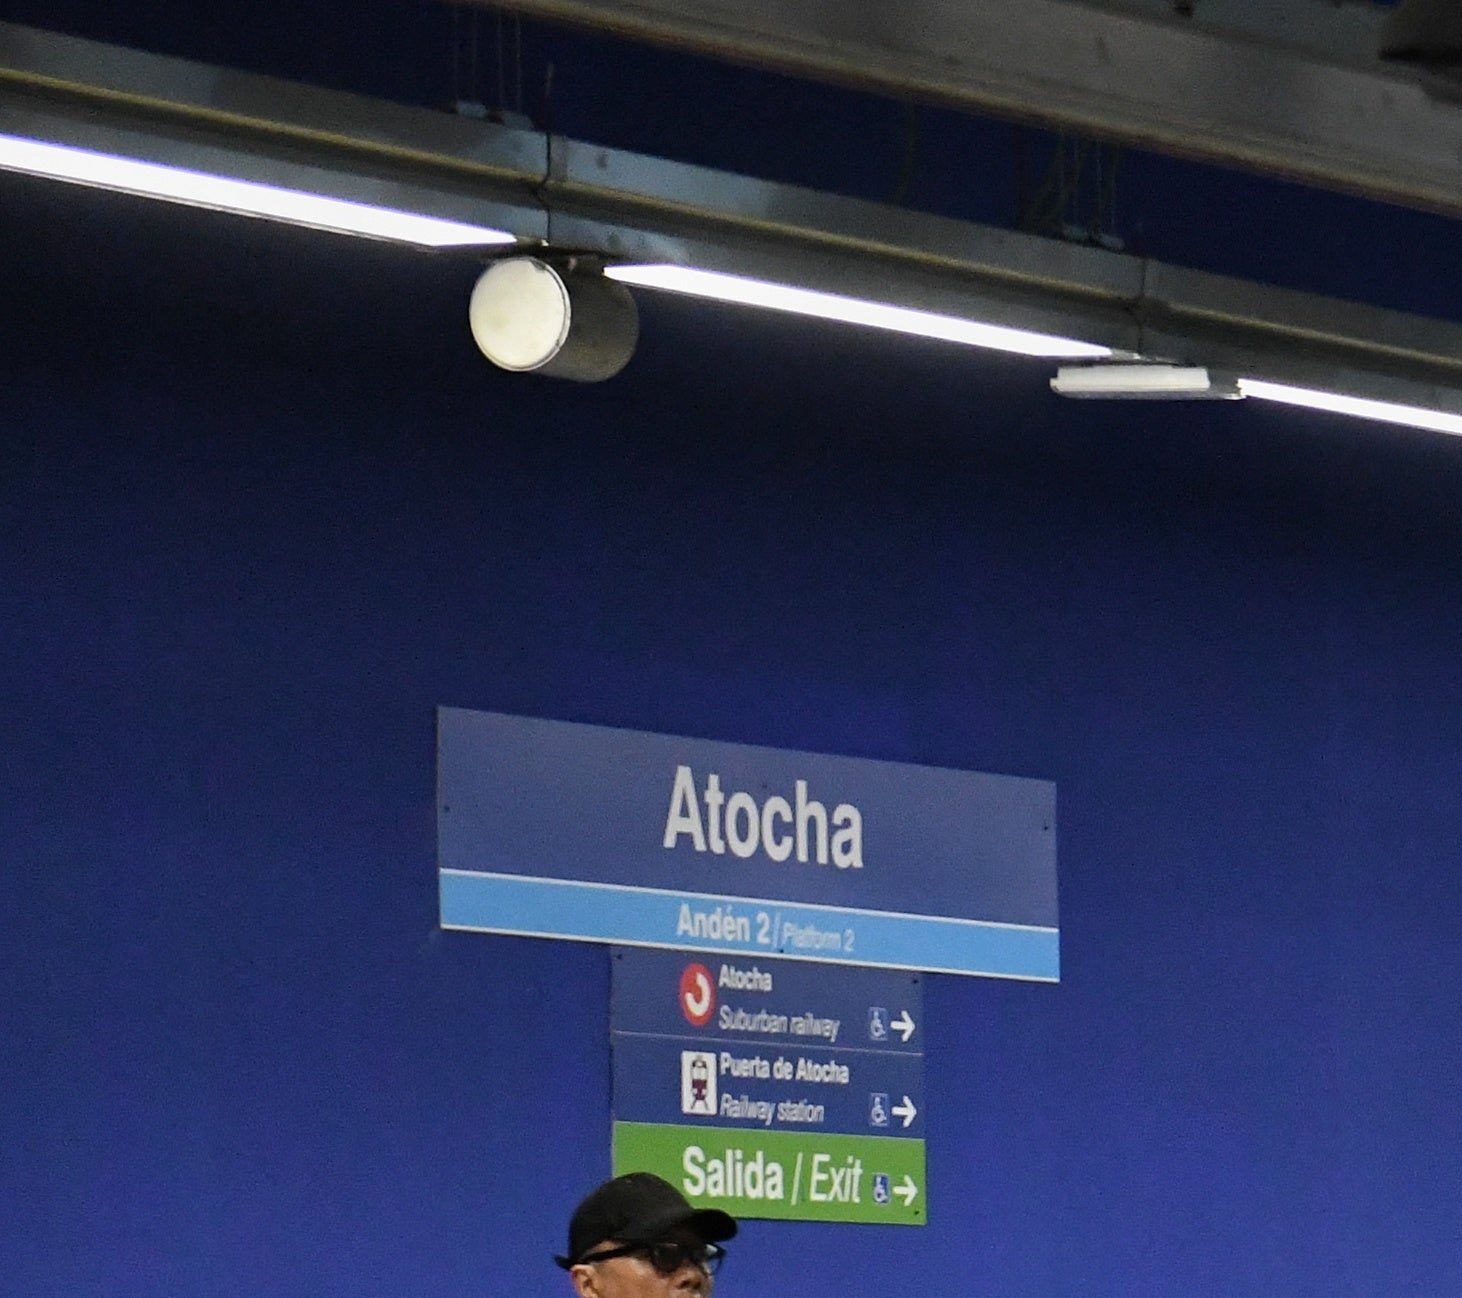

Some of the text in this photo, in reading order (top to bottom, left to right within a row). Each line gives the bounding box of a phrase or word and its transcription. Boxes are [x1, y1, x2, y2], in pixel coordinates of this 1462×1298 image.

[663, 764, 864, 869] Atocha
[676, 903, 751, 942] Andén
[718, 963, 773, 992] Atocha
[718, 1004, 841, 1042] Suburban railway
[719, 1051, 850, 1084] Puerta de Atocha
[719, 1093, 825, 1126] Railway station
[682, 1145, 785, 1200] Salida
[809, 1153, 864, 1203] Exit
